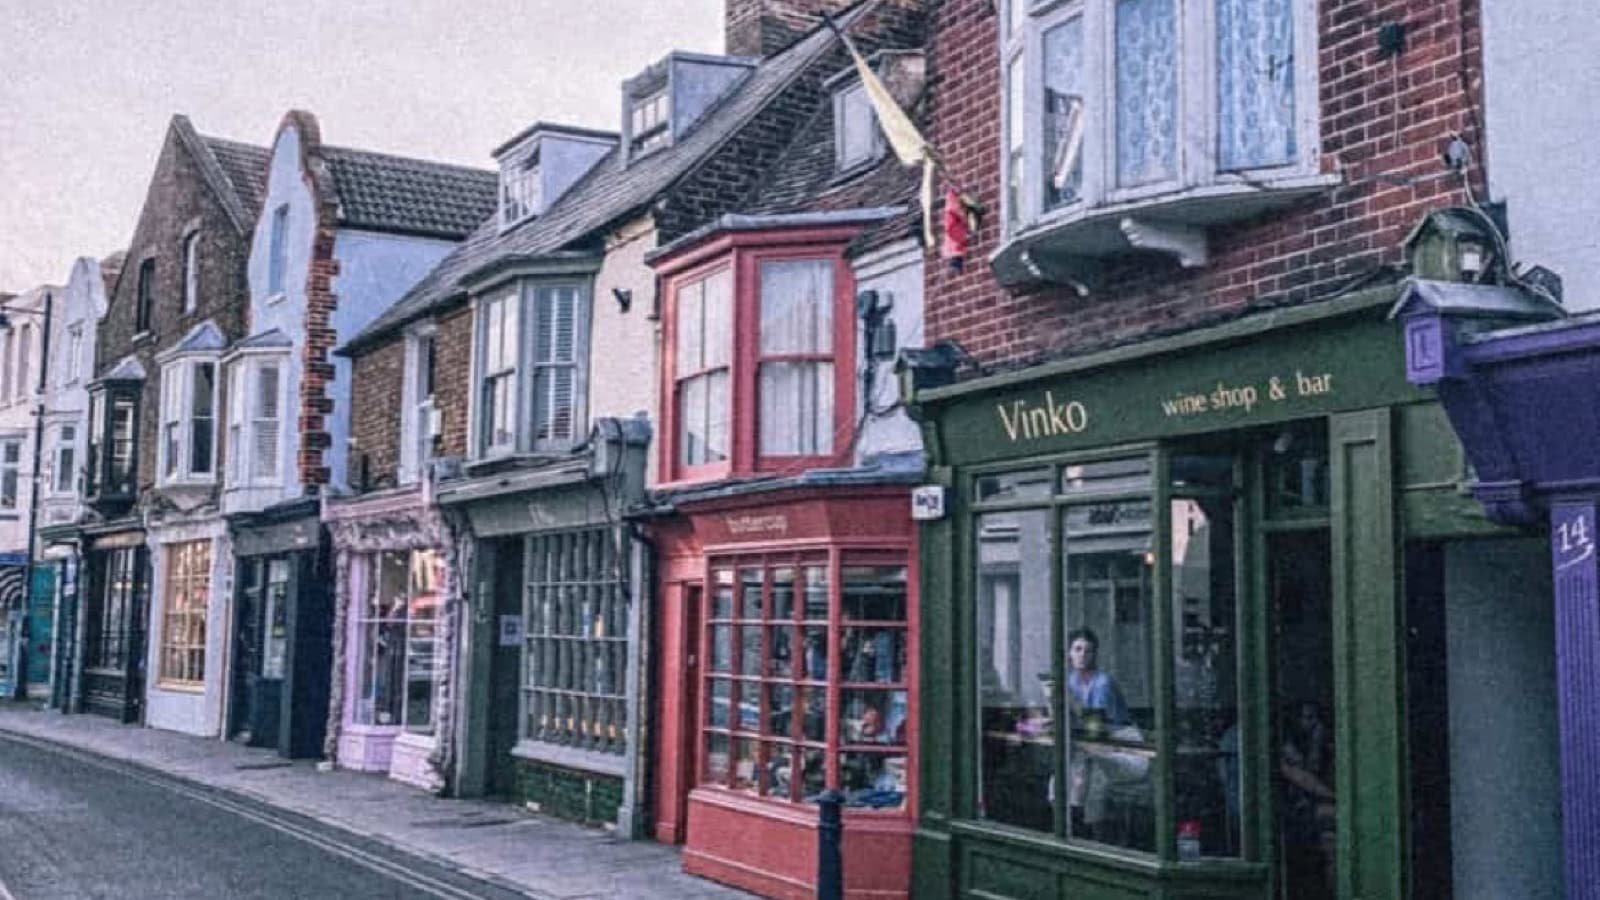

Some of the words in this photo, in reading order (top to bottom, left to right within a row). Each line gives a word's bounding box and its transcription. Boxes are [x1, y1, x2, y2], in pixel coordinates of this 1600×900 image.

[997, 390, 1087, 441] Vinko
[1161, 391, 1207, 417] wine
[1210, 380, 1258, 412] shop
[1268, 376, 1286, 400] &
[1295, 370, 1332, 396] bar
[1558, 514, 1590, 553] 14
